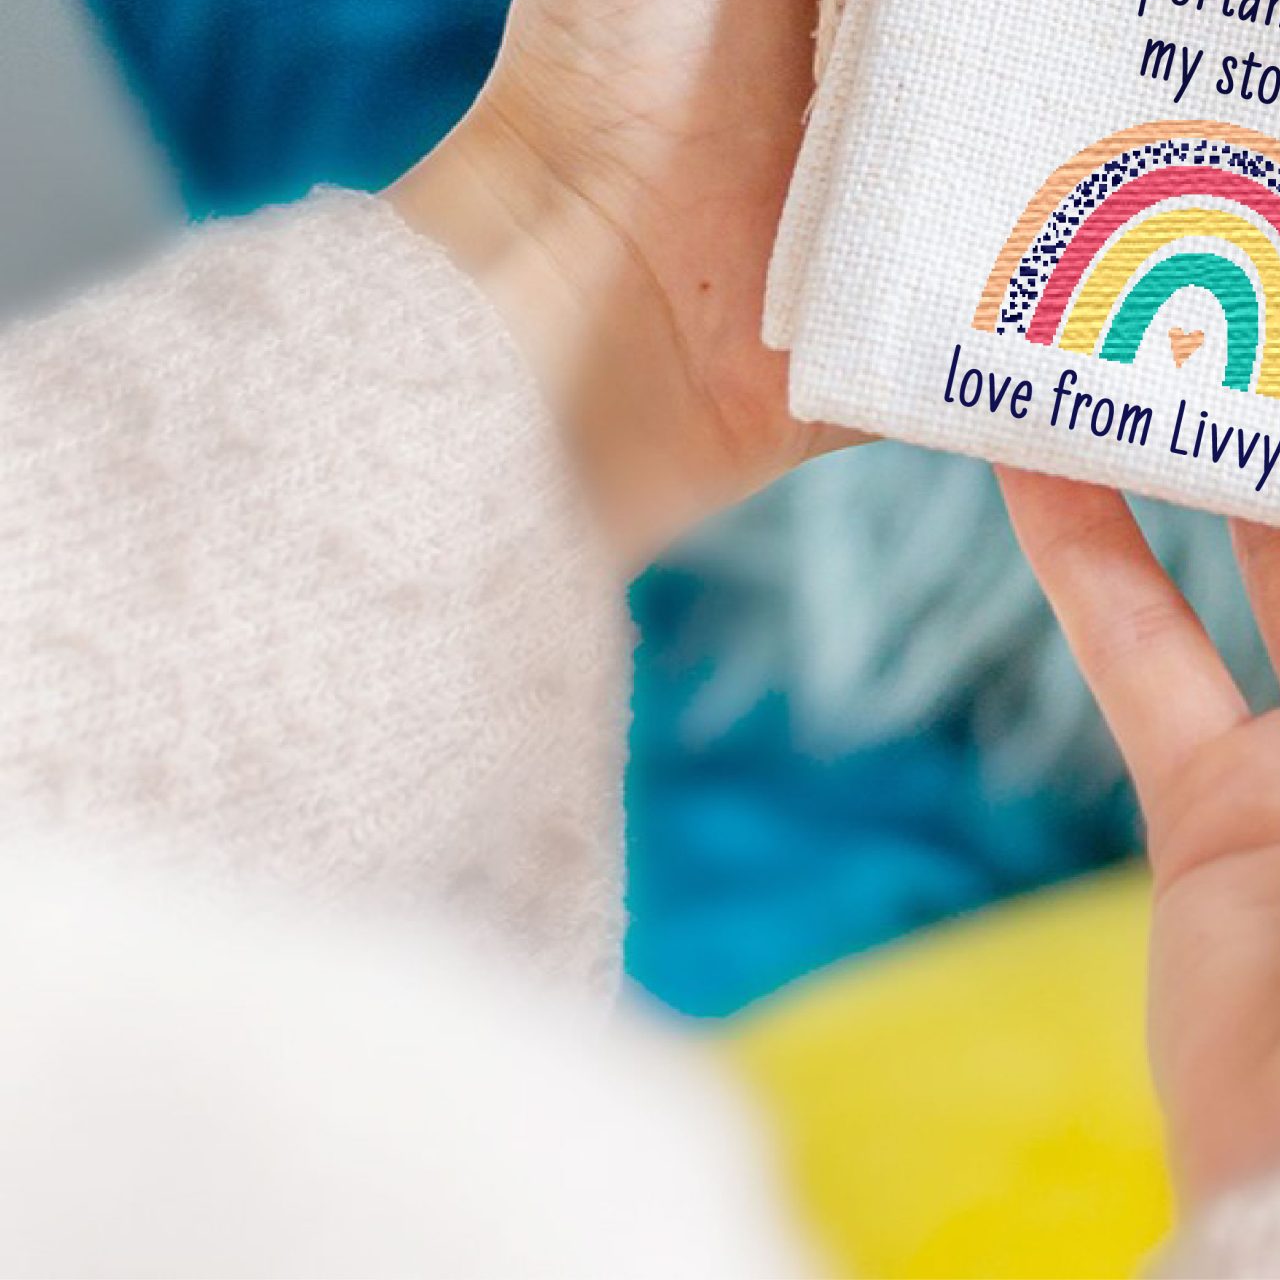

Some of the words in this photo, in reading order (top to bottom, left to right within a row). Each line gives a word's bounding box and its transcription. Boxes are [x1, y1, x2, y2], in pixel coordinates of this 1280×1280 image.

[1139, 37, 1204, 104] my
[943, 343, 1034, 419] love
[1050, 369, 1153, 447] from
